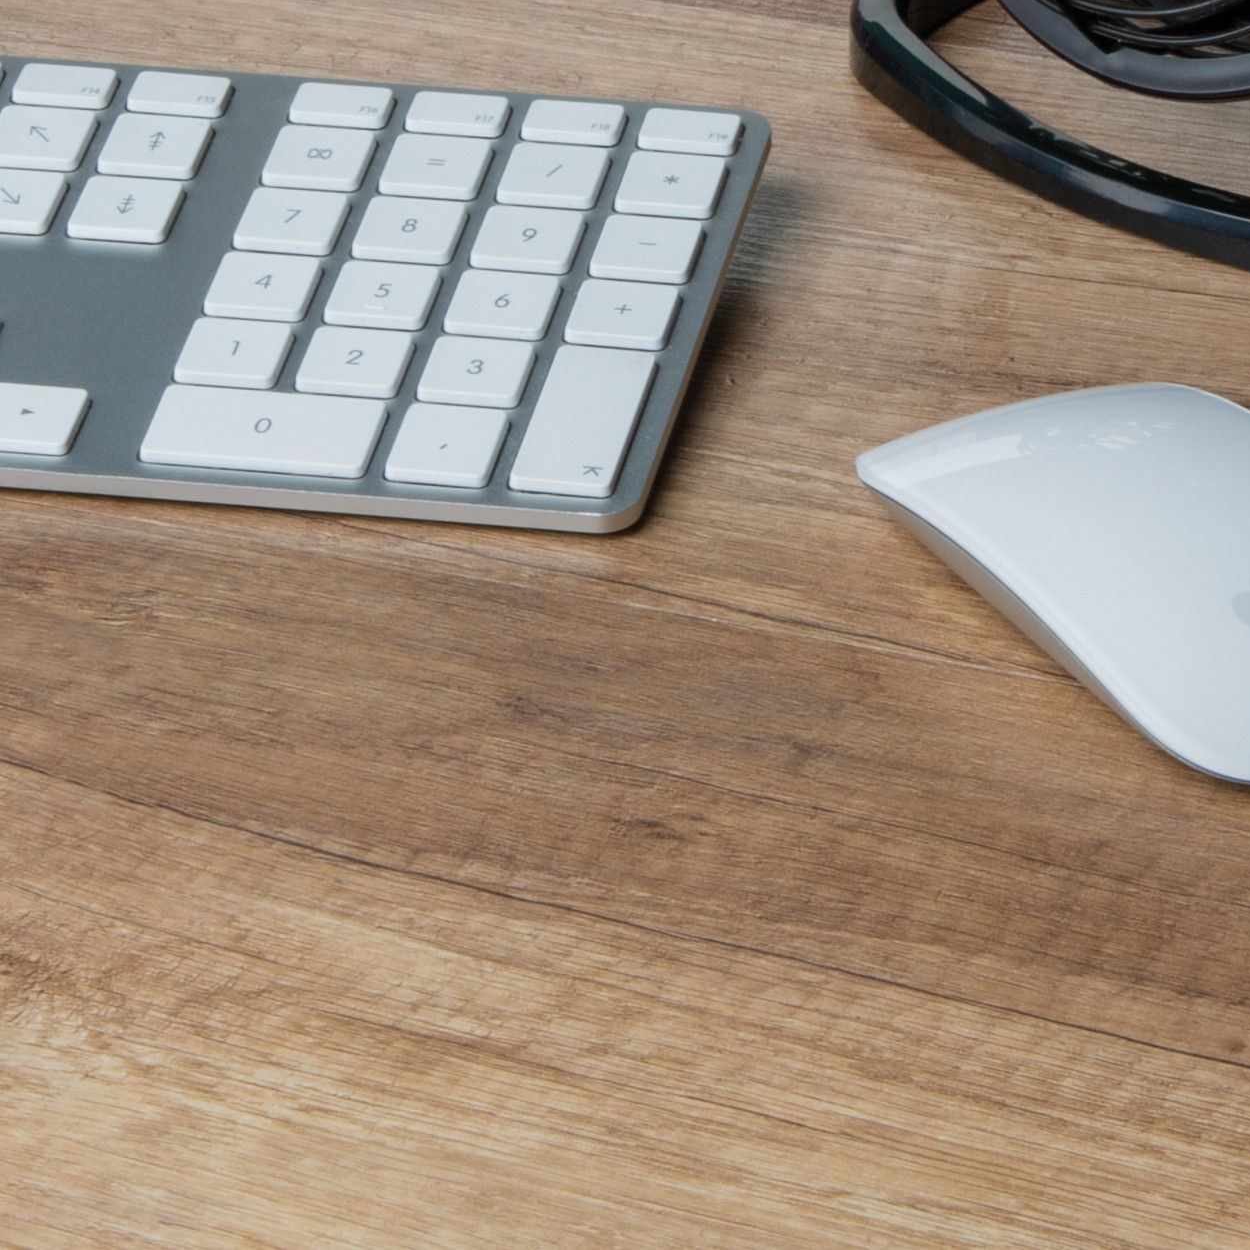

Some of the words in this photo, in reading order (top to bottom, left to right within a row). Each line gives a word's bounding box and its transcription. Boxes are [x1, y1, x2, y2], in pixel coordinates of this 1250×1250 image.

[283, 208, 302, 224] 7
[401, 218, 418, 234] 8
[521, 227, 538, 243] 9
[254, 274, 272, 290] 4
[373, 282, 392, 299] 5
[494, 293, 510, 309] 6
[231, 340, 241, 356] 1
[345, 349, 364, 366] 2
[466, 359, 485, 375] 3
[253, 417, 273, 434] 0
